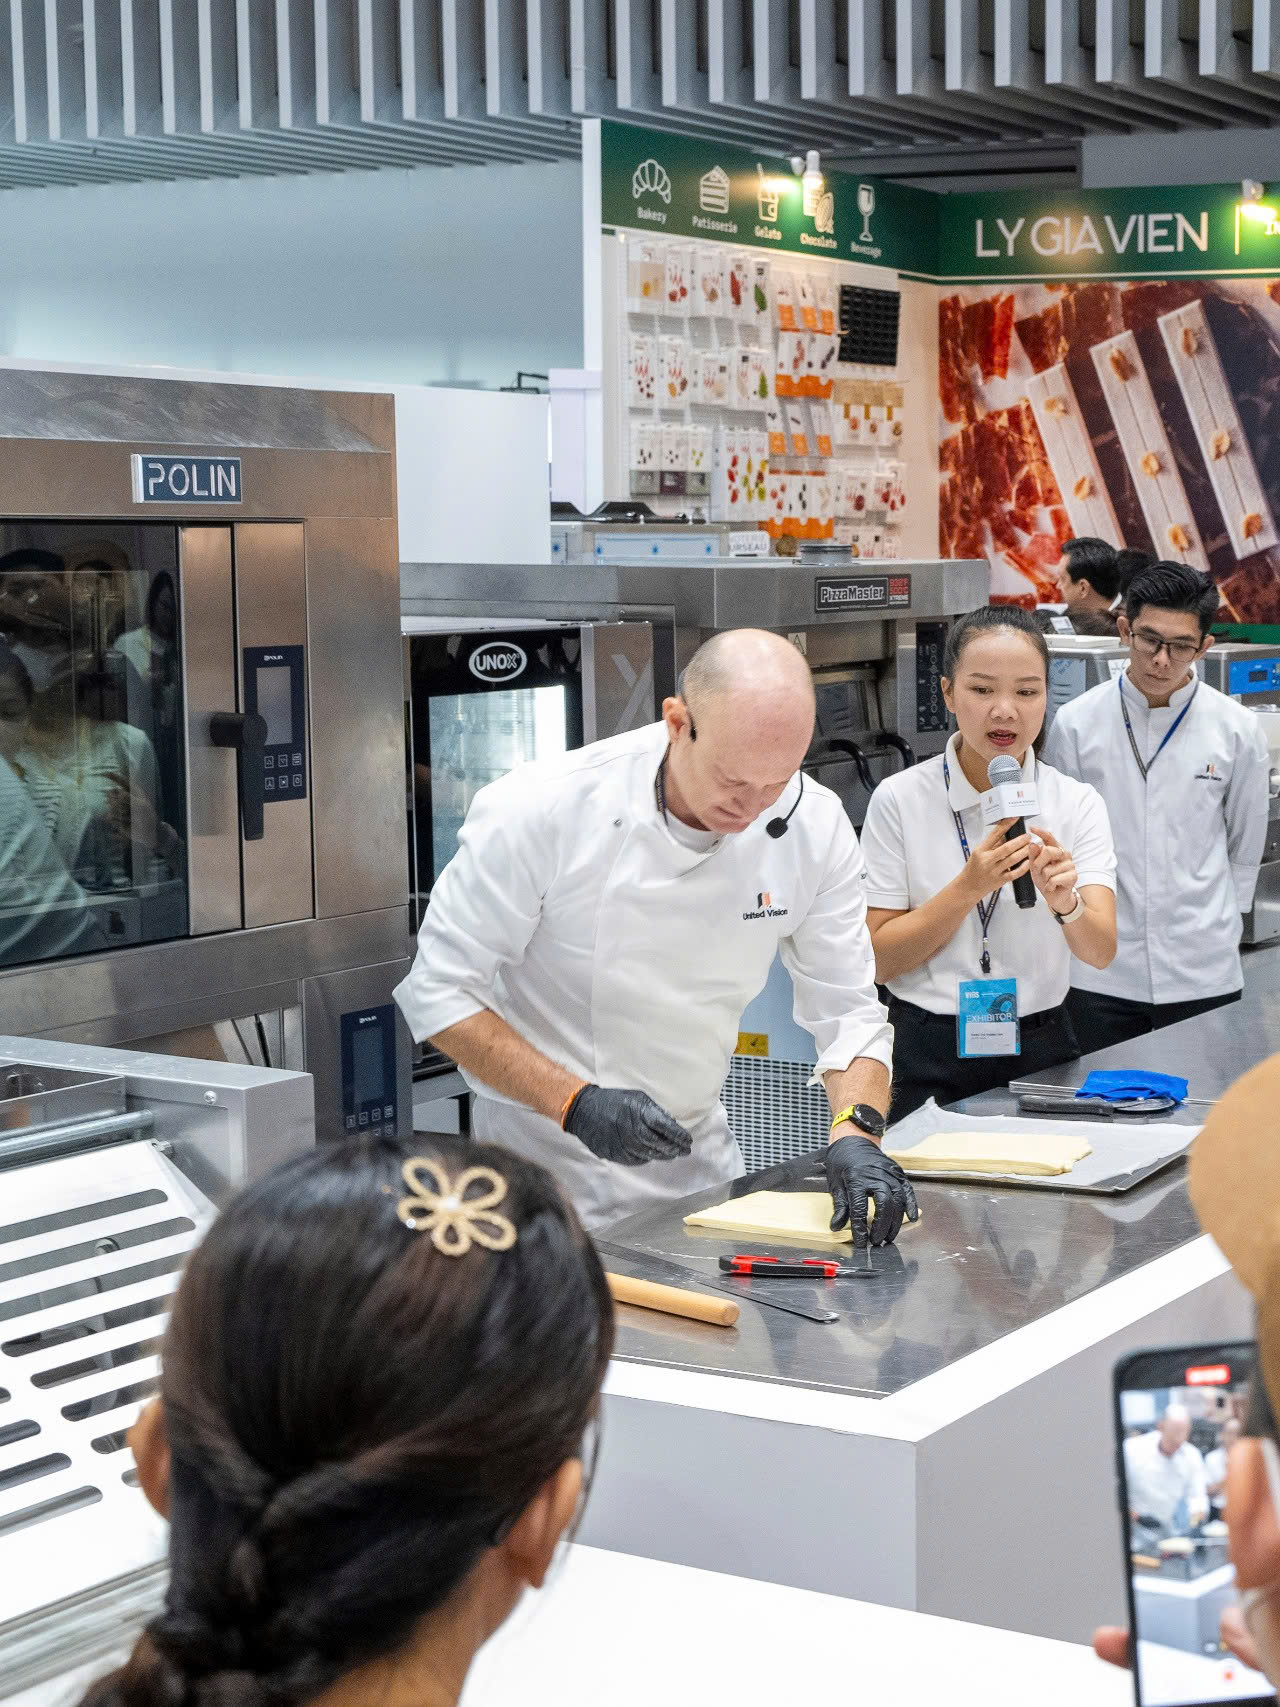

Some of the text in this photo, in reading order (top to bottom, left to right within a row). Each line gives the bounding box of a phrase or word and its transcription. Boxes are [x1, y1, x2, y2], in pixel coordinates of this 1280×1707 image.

[637, 206, 667, 225] Bakery
[692, 215, 739, 234] Patisserie
[800, 232, 838, 249] Chocolate
[148, 462, 236, 497] POLIN
[820, 585, 884, 603] PizzaMaster
[475, 653, 518, 671] UNOX
[742, 905, 788, 920] United Vision
[966, 1012, 1012, 1023] EXHIBITOR
